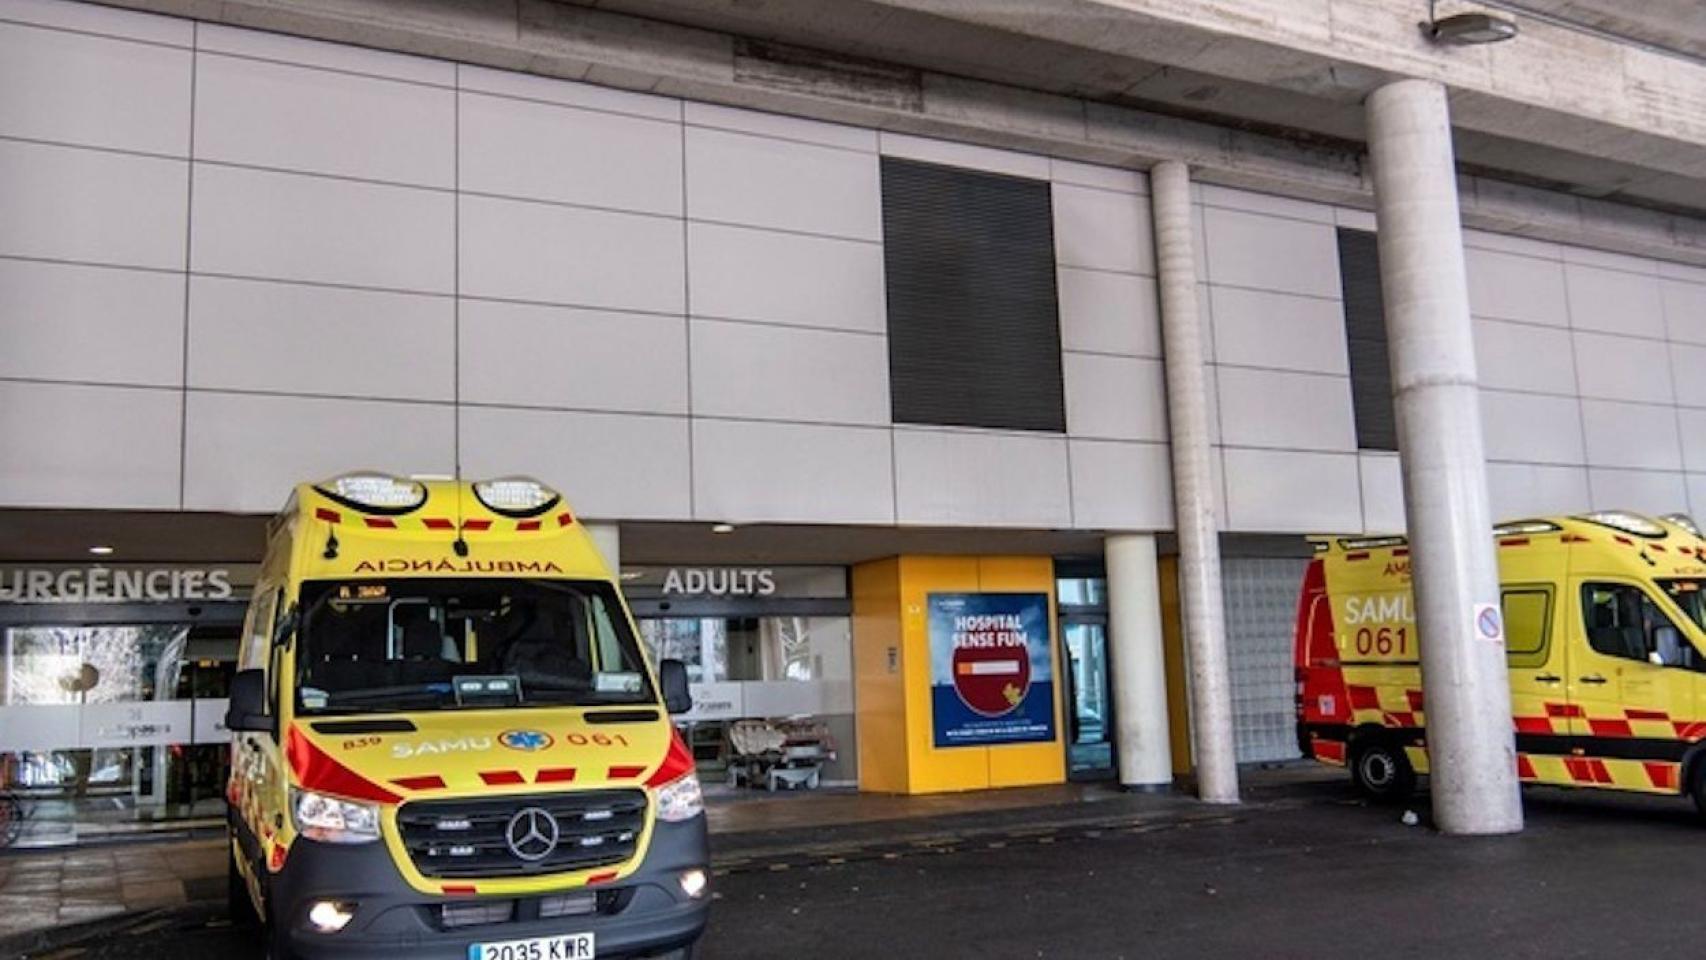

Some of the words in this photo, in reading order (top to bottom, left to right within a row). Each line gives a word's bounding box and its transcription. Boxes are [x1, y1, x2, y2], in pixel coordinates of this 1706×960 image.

[0, 564, 233, 600] URGÈNCIES
[662, 568, 775, 595] ADULTS
[954, 614, 1023, 632] HOSPITAL
[952, 631, 996, 648] SENSE
[997, 631, 1028, 648] FUM
[1356, 627, 1406, 656] 061
[391, 737, 491, 758] SAMU
[566, 733, 629, 747] 061
[486, 941, 542, 960] 2035
[549, 938, 589, 959] KWR
